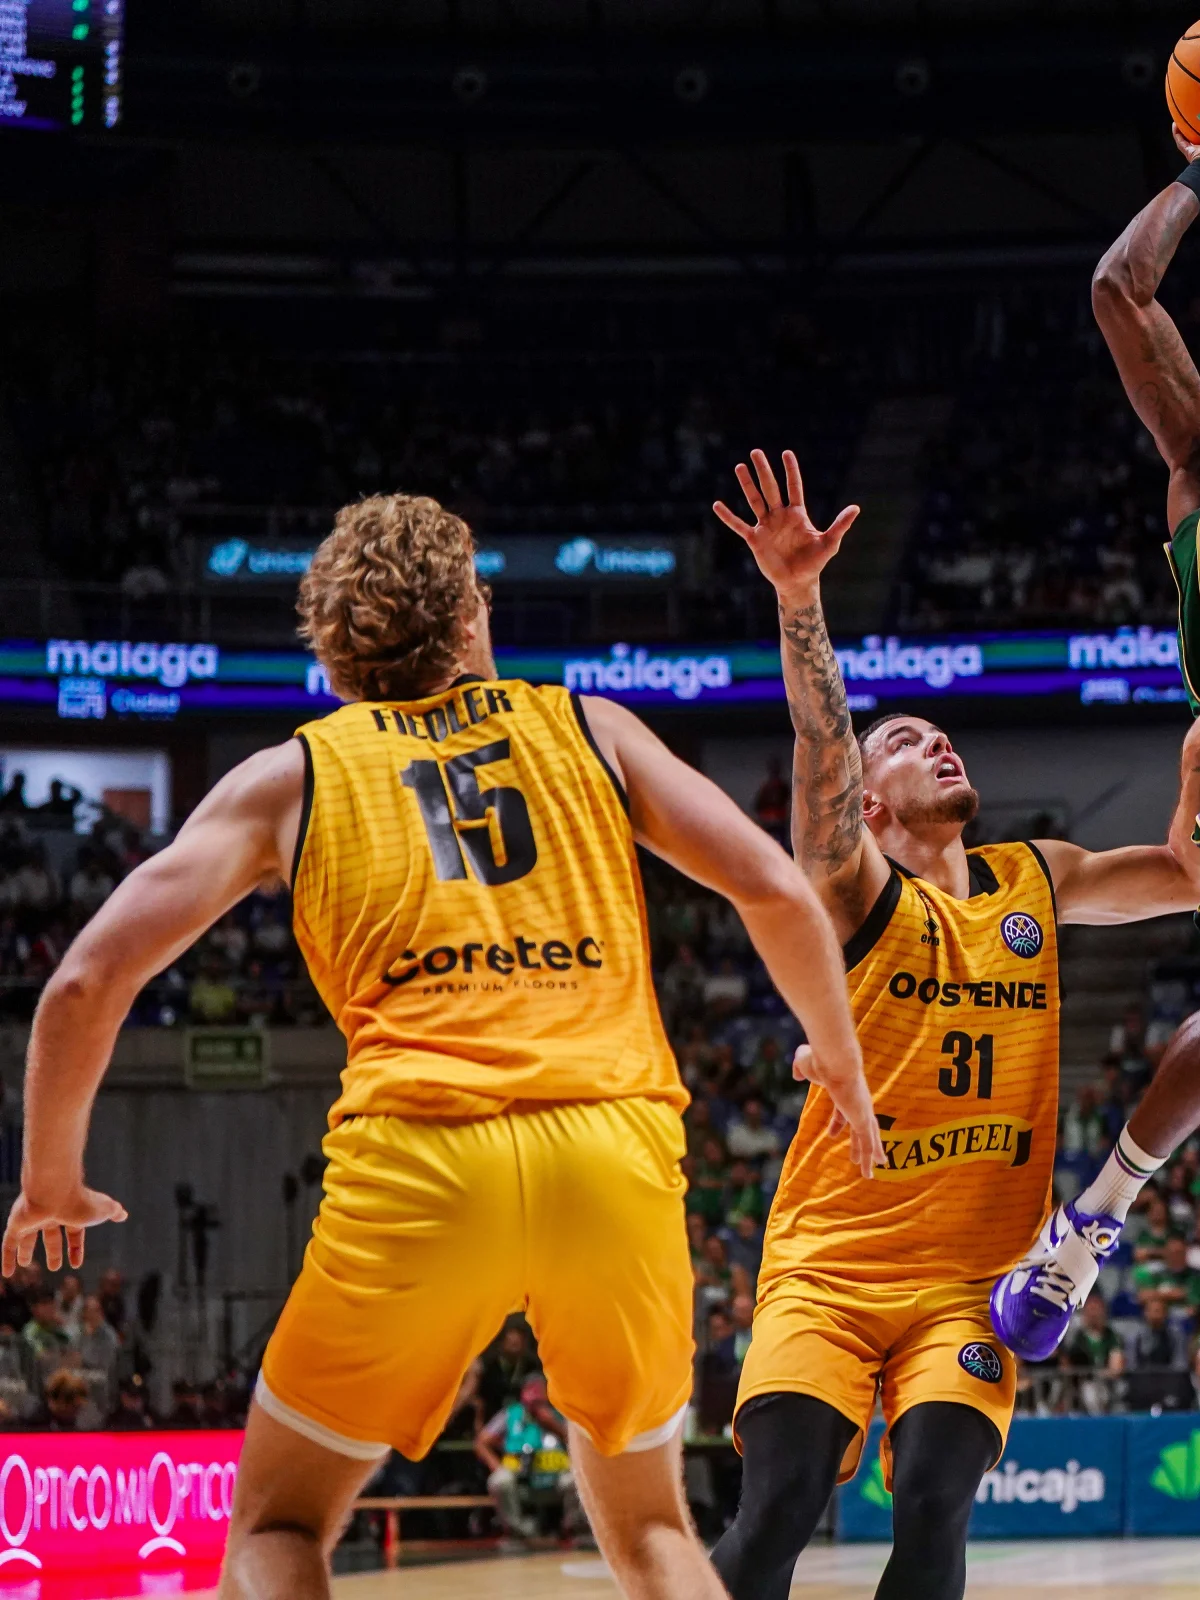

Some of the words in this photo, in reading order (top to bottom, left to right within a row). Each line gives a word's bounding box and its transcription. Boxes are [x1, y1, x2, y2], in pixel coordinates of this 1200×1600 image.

[1068, 625, 1179, 669] mála
[371, 686, 514, 742] FIEDLER
[400, 737, 538, 886] 15
[382, 935, 603, 986] coretec
[423, 982, 503, 996] PREMIUM
[513, 980, 578, 990] FLOORS
[889, 971, 1047, 1010] OOSTENDE
[938, 1031, 994, 1100] 31
[875, 1124, 1013, 1170] KASTEEL
[975, 1459, 1104, 1513] nicaja
